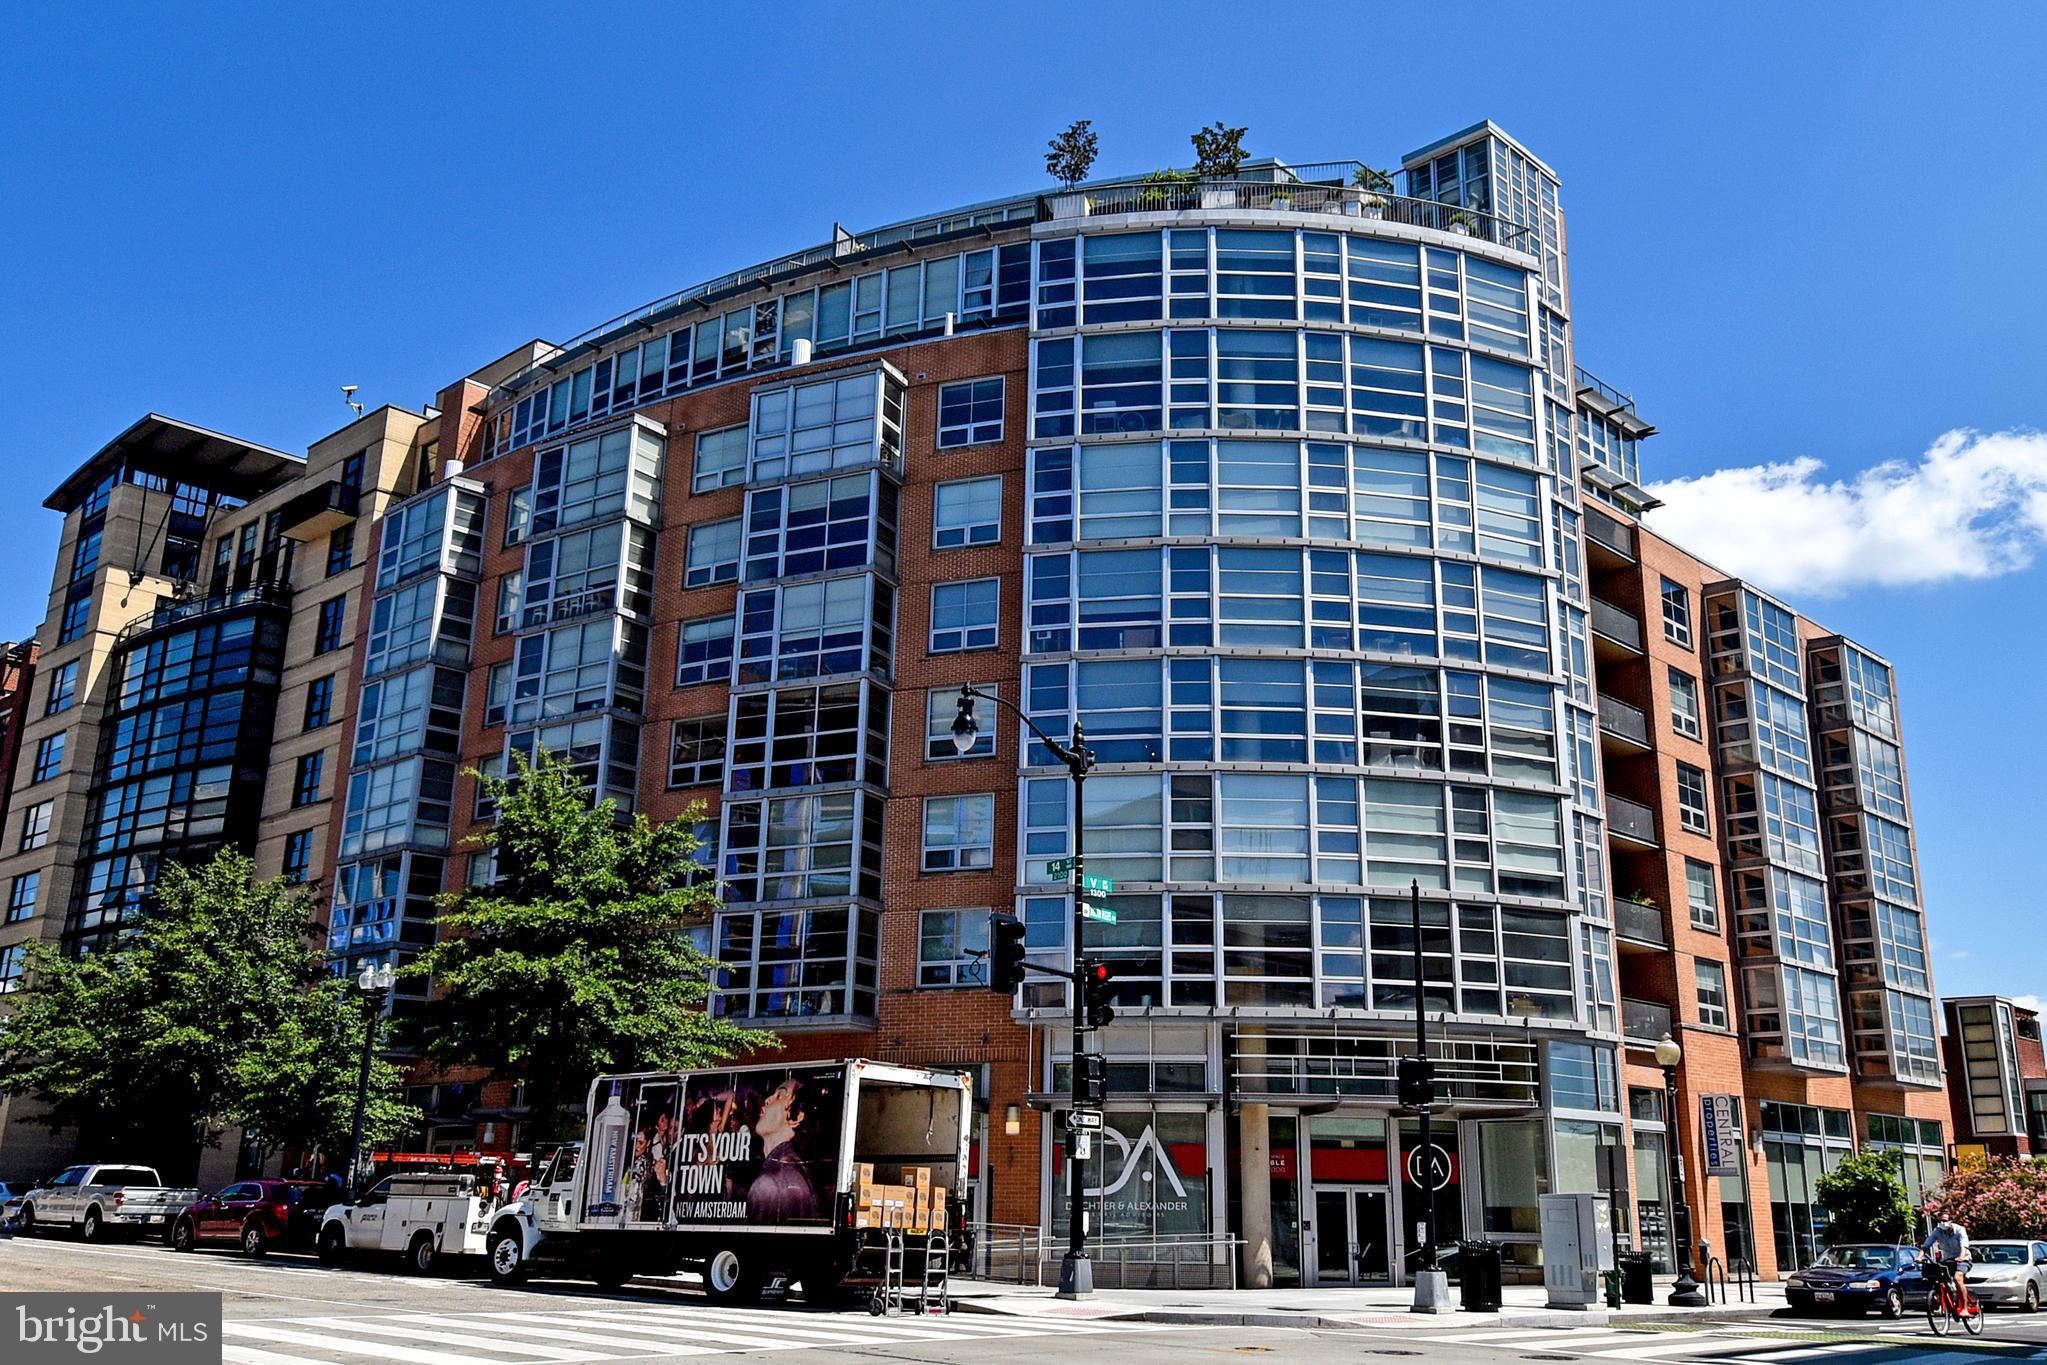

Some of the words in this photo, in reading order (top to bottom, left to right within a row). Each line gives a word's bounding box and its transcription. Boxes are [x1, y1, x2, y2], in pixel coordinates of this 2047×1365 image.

[1051, 861, 1060, 872] 14
[1090, 878, 1097, 889] V
[1090, 889, 1107, 898] 1300
[1703, 1099, 1719, 1166] properties
[1715, 1096, 1735, 1167] CENTRAL
[681, 1133, 709, 1163] IT'S
[711, 1131, 752, 1162] YOUR
[680, 1164, 724, 1195] TOWN
[676, 1201, 695, 1218] NEW
[1065, 1201, 1116, 1211] DCHTER
[1118, 1201, 1125, 1211] &
